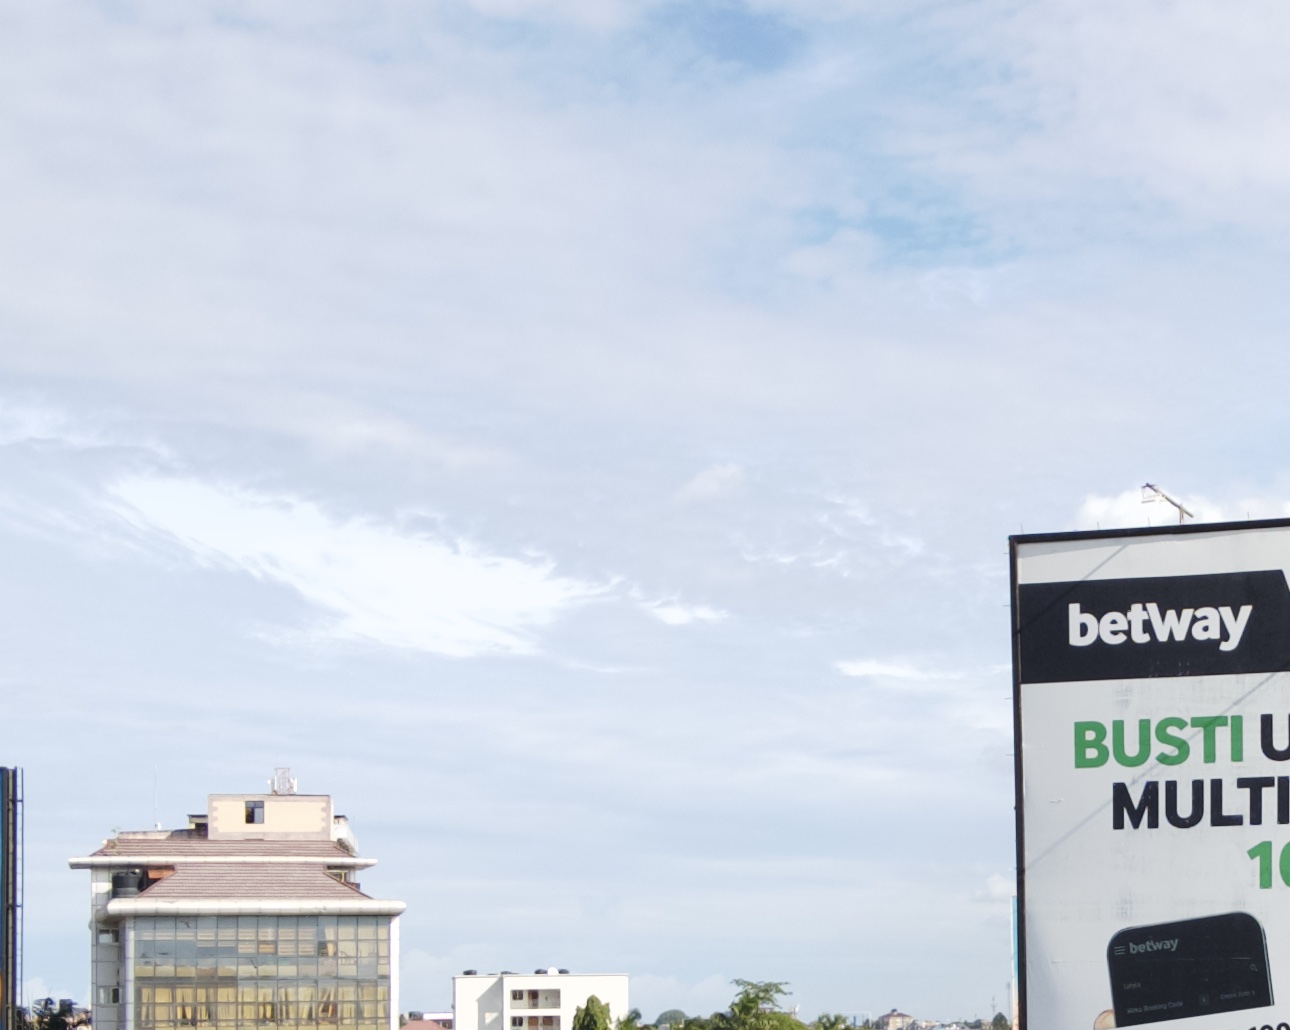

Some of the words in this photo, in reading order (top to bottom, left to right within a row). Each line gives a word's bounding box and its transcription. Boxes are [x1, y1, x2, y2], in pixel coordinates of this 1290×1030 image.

[1068, 602, 1253, 652] betway
[1074, 715, 1243, 769] BUSTI
[1112, 775, 1290, 831] MULTI
[1128, 938, 1179, 955] betway
